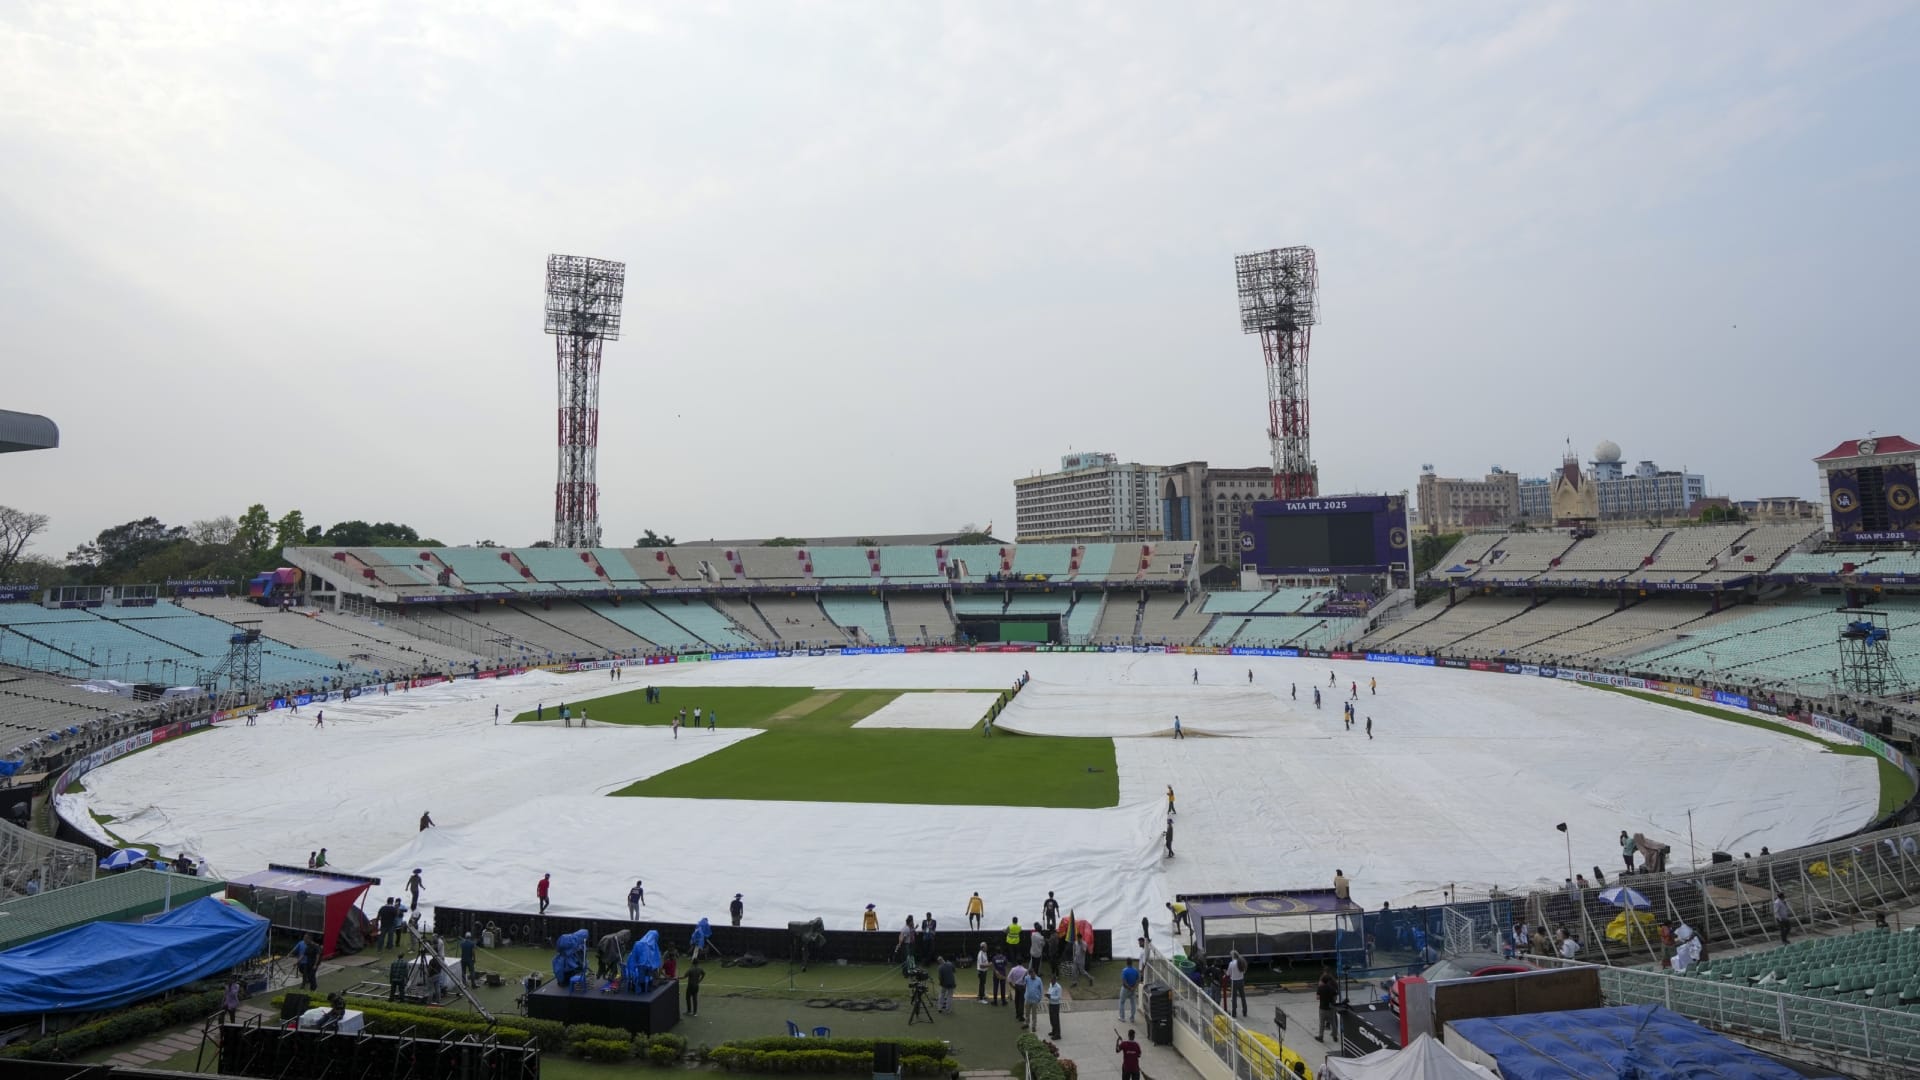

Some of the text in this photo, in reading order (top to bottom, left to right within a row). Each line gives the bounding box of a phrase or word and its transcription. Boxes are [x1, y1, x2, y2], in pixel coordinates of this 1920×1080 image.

[1286, 501, 1347, 511] TATA IPL 2025
